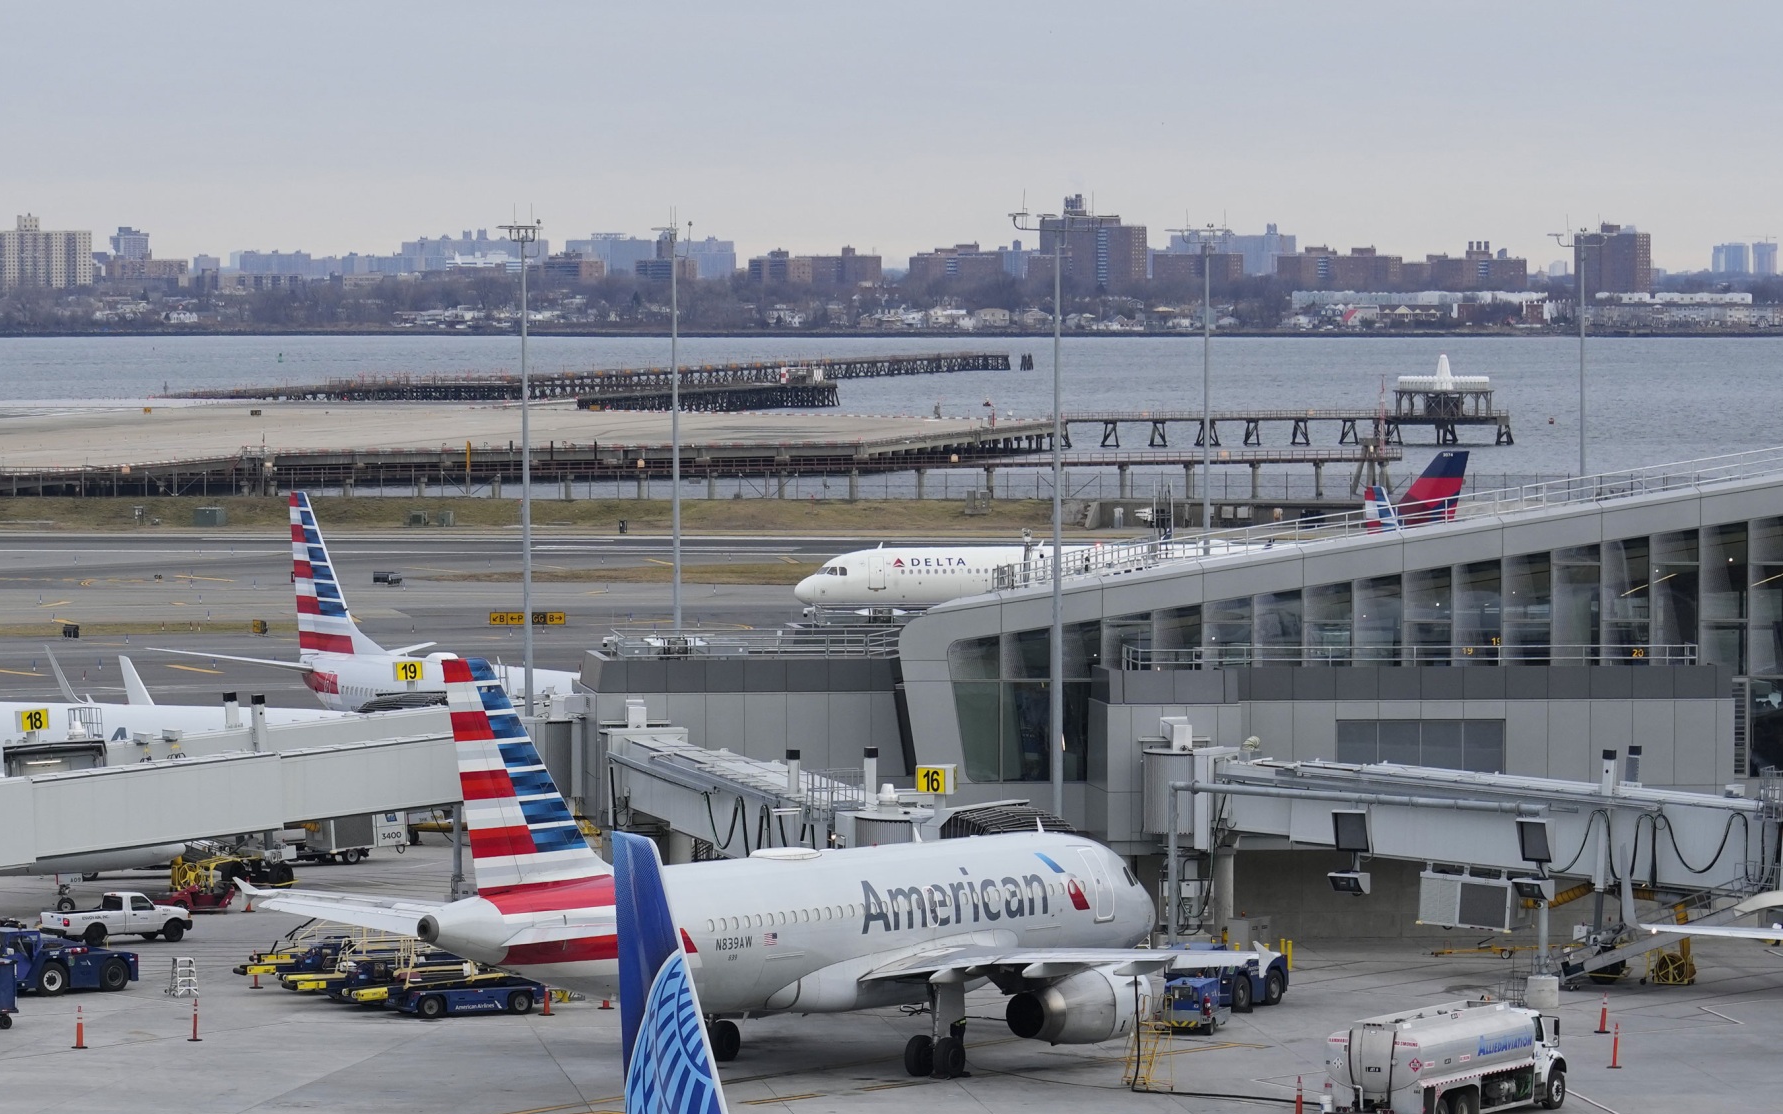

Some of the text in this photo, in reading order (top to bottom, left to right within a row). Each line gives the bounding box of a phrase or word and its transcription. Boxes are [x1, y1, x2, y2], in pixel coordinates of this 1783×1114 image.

[908, 557, 966, 567] DELTA
[401, 663, 417, 680] 19
[25, 711, 43, 730] 18
[923, 770, 940, 792] 16
[381, 830, 402, 840] 3400
[861, 866, 1049, 935] American
[715, 935, 753, 951] N839AW
[454, 1002, 495, 1011] American Airlines
